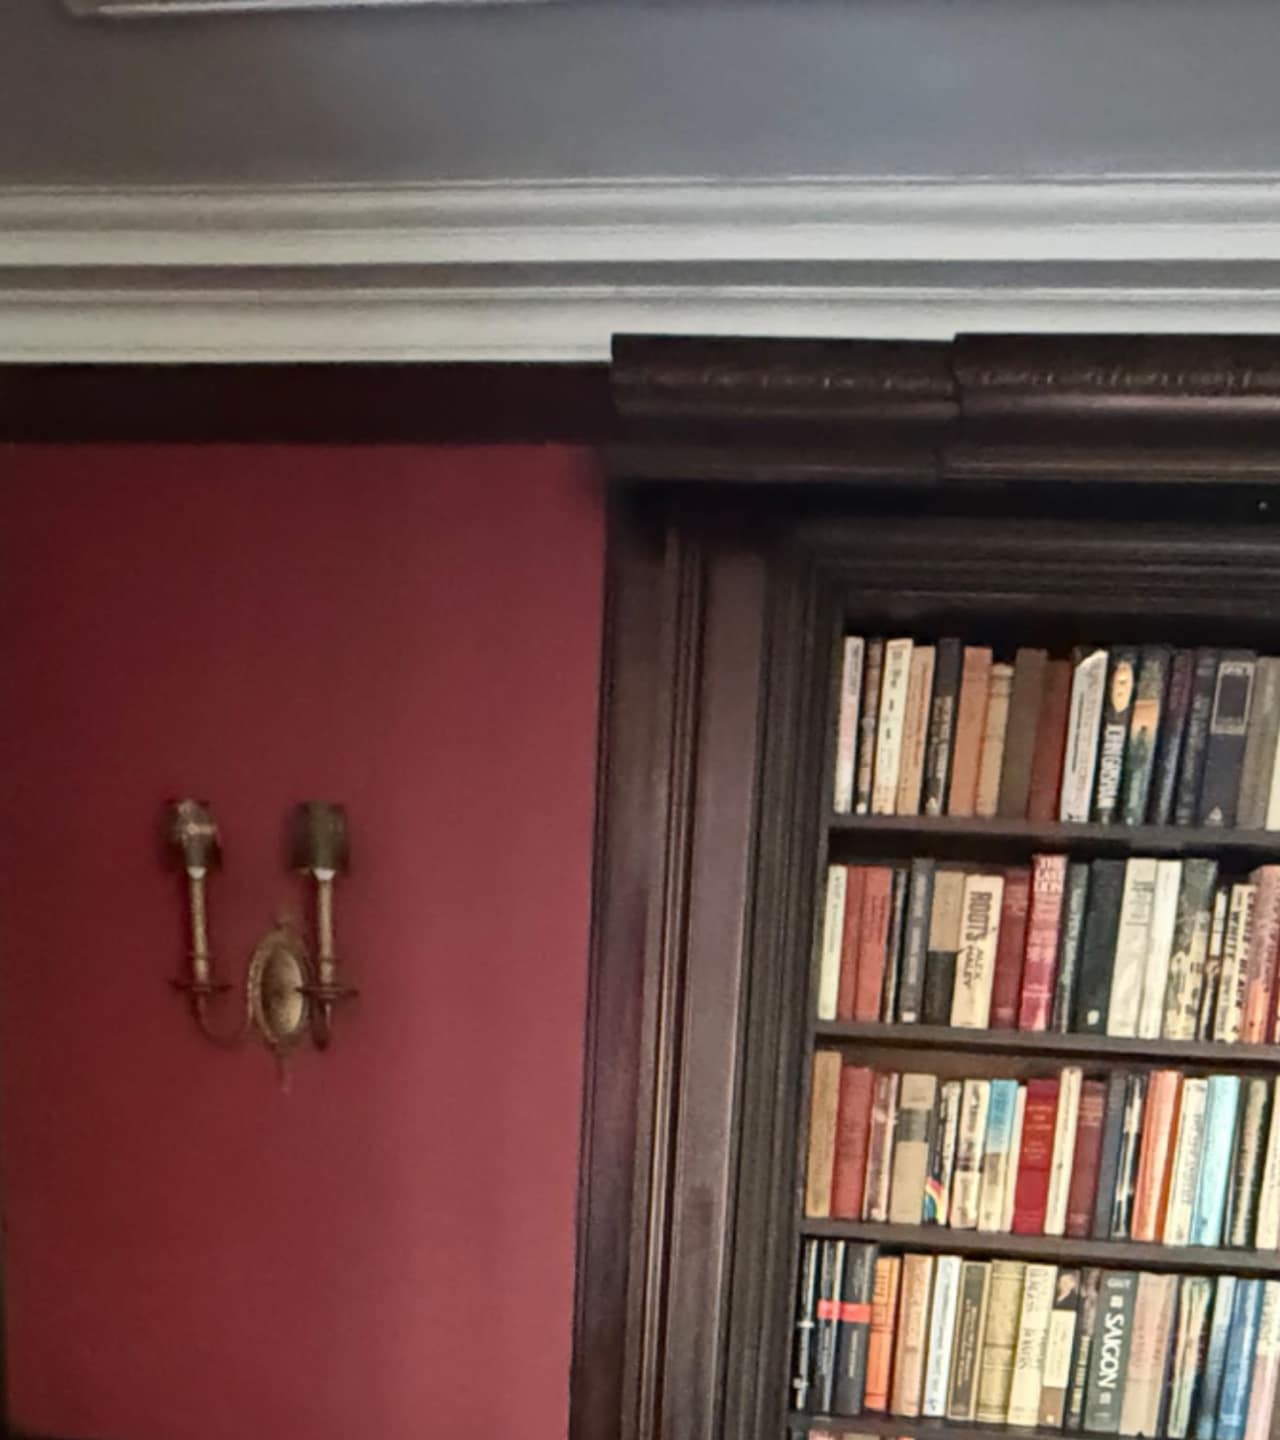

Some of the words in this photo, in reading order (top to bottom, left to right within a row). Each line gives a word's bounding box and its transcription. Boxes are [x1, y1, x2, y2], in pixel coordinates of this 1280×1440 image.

[966, 891, 992, 941] ROOTS
[1227, 911, 1241, 961] WHITE
[963, 945, 974, 990] HALEY
[974, 948, 985, 981] ALEX
[1098, 1312, 1126, 1389] SAIGON
